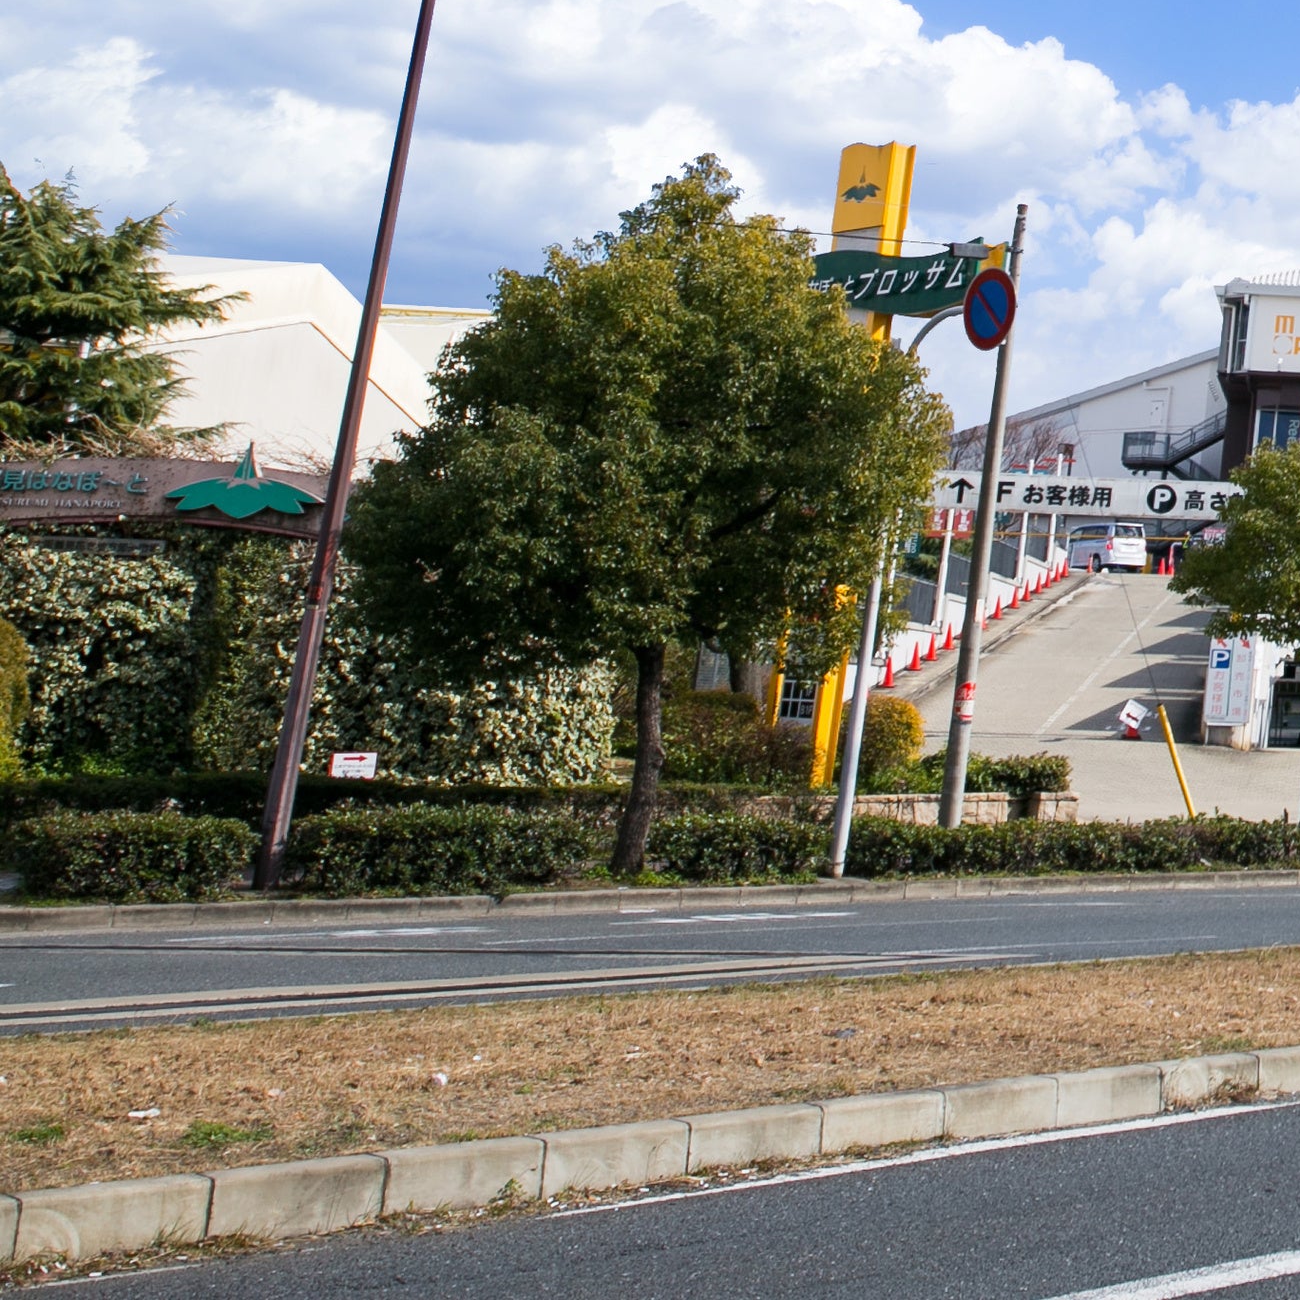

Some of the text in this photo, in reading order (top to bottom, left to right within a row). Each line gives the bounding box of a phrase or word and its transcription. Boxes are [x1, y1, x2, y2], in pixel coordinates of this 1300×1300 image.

[808, 258, 964, 300] なぽとブロッサム
[0, 469, 149, 495] 見はなぽ～と
[1022, 483, 1113, 508] お客様用
